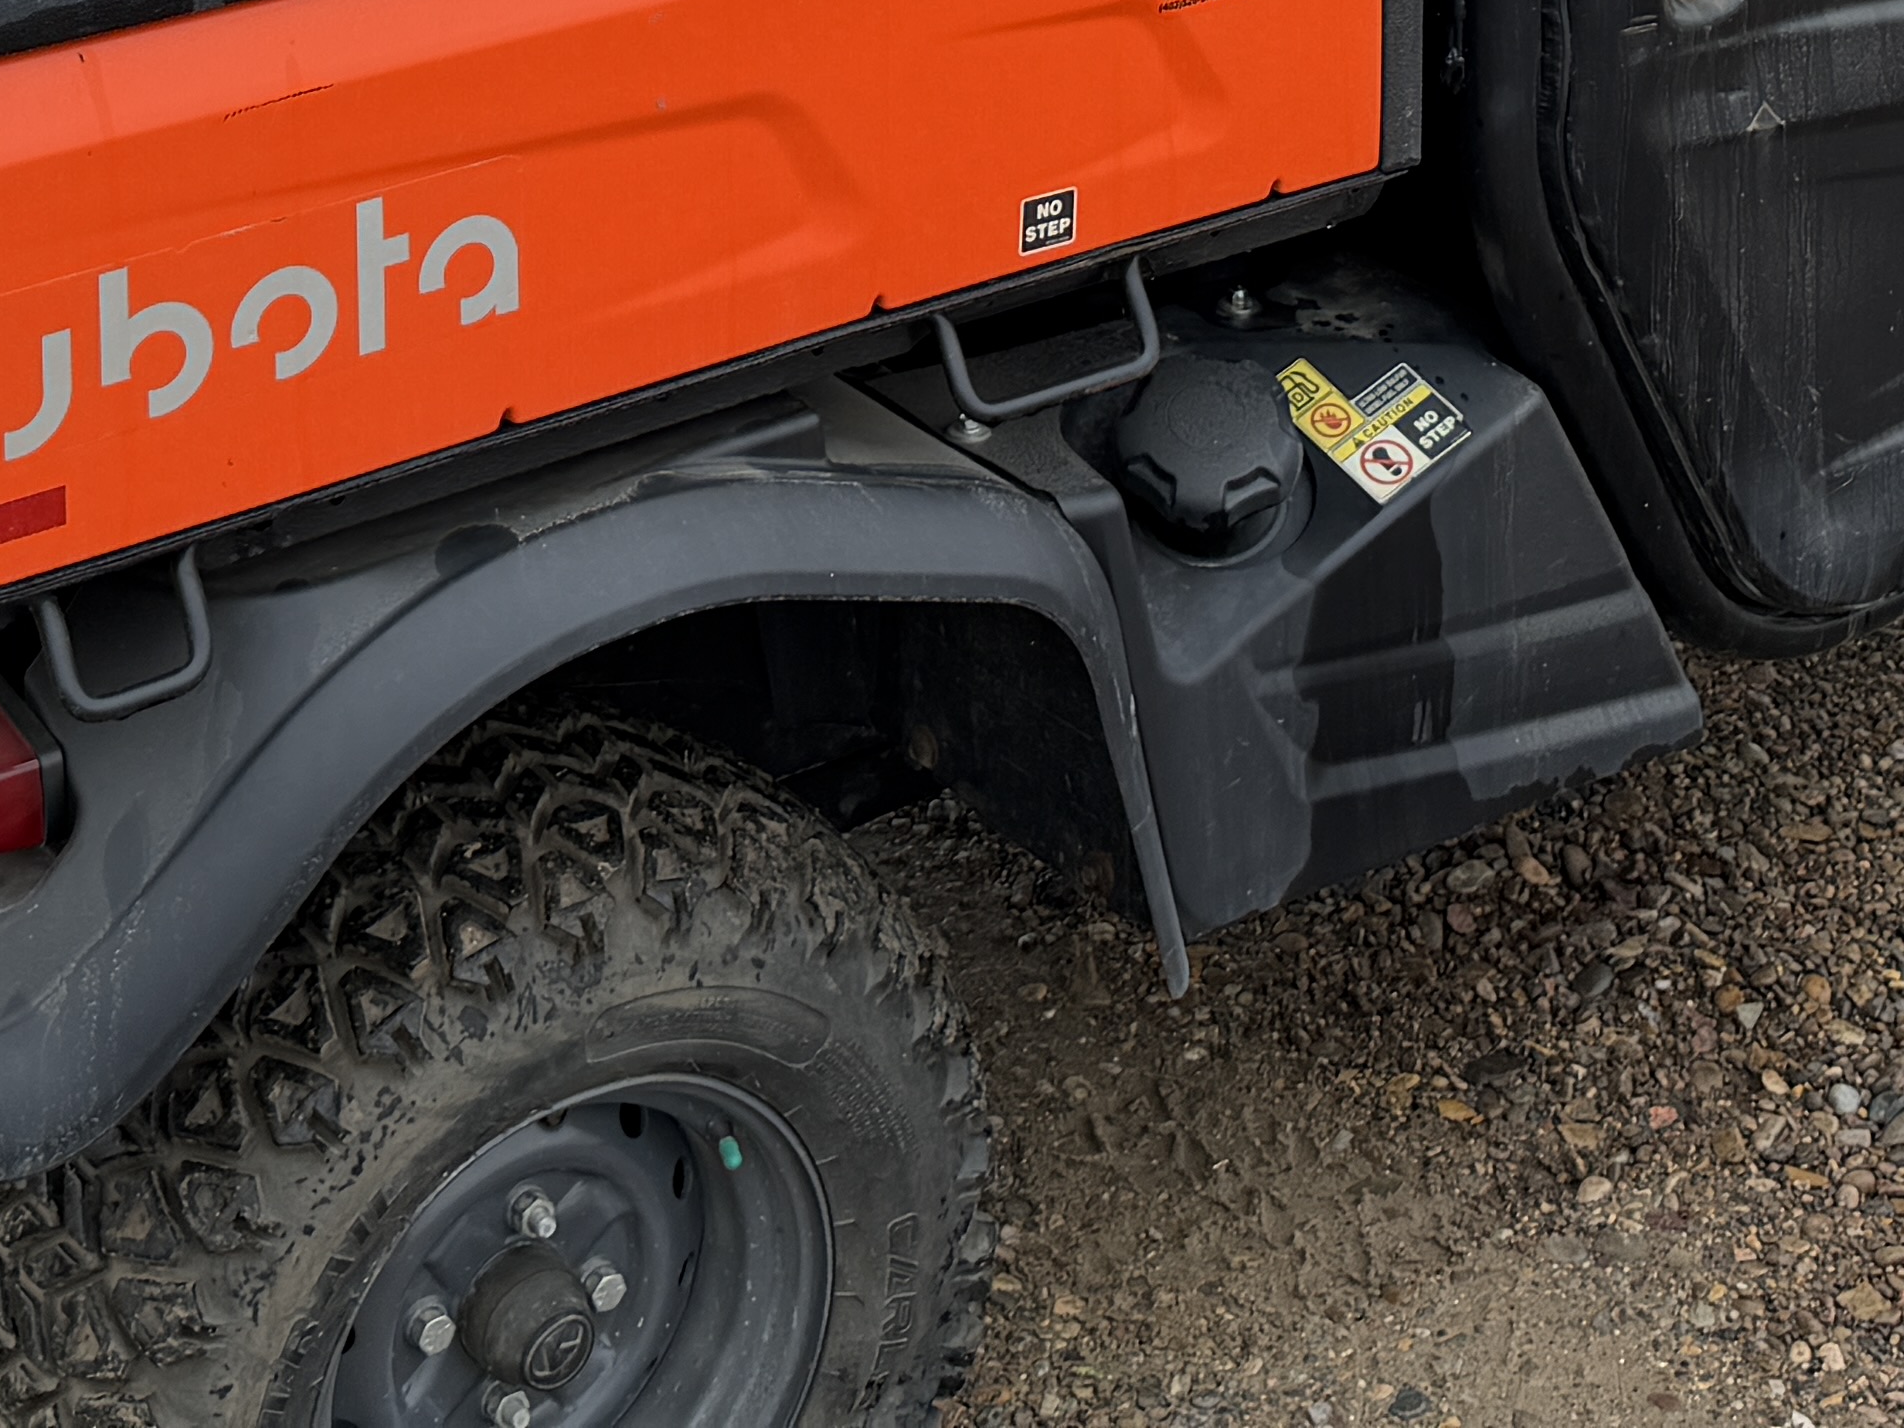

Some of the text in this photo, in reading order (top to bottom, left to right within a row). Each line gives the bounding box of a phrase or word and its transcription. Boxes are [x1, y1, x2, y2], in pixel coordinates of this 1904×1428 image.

[1037, 199, 1063, 220] NO
[1025, 217, 1071, 243] STEP
[1362, 397, 1414, 438] CAUTION
[1413, 410, 1439, 432] NO
[1419, 415, 1456, 449] STEP
